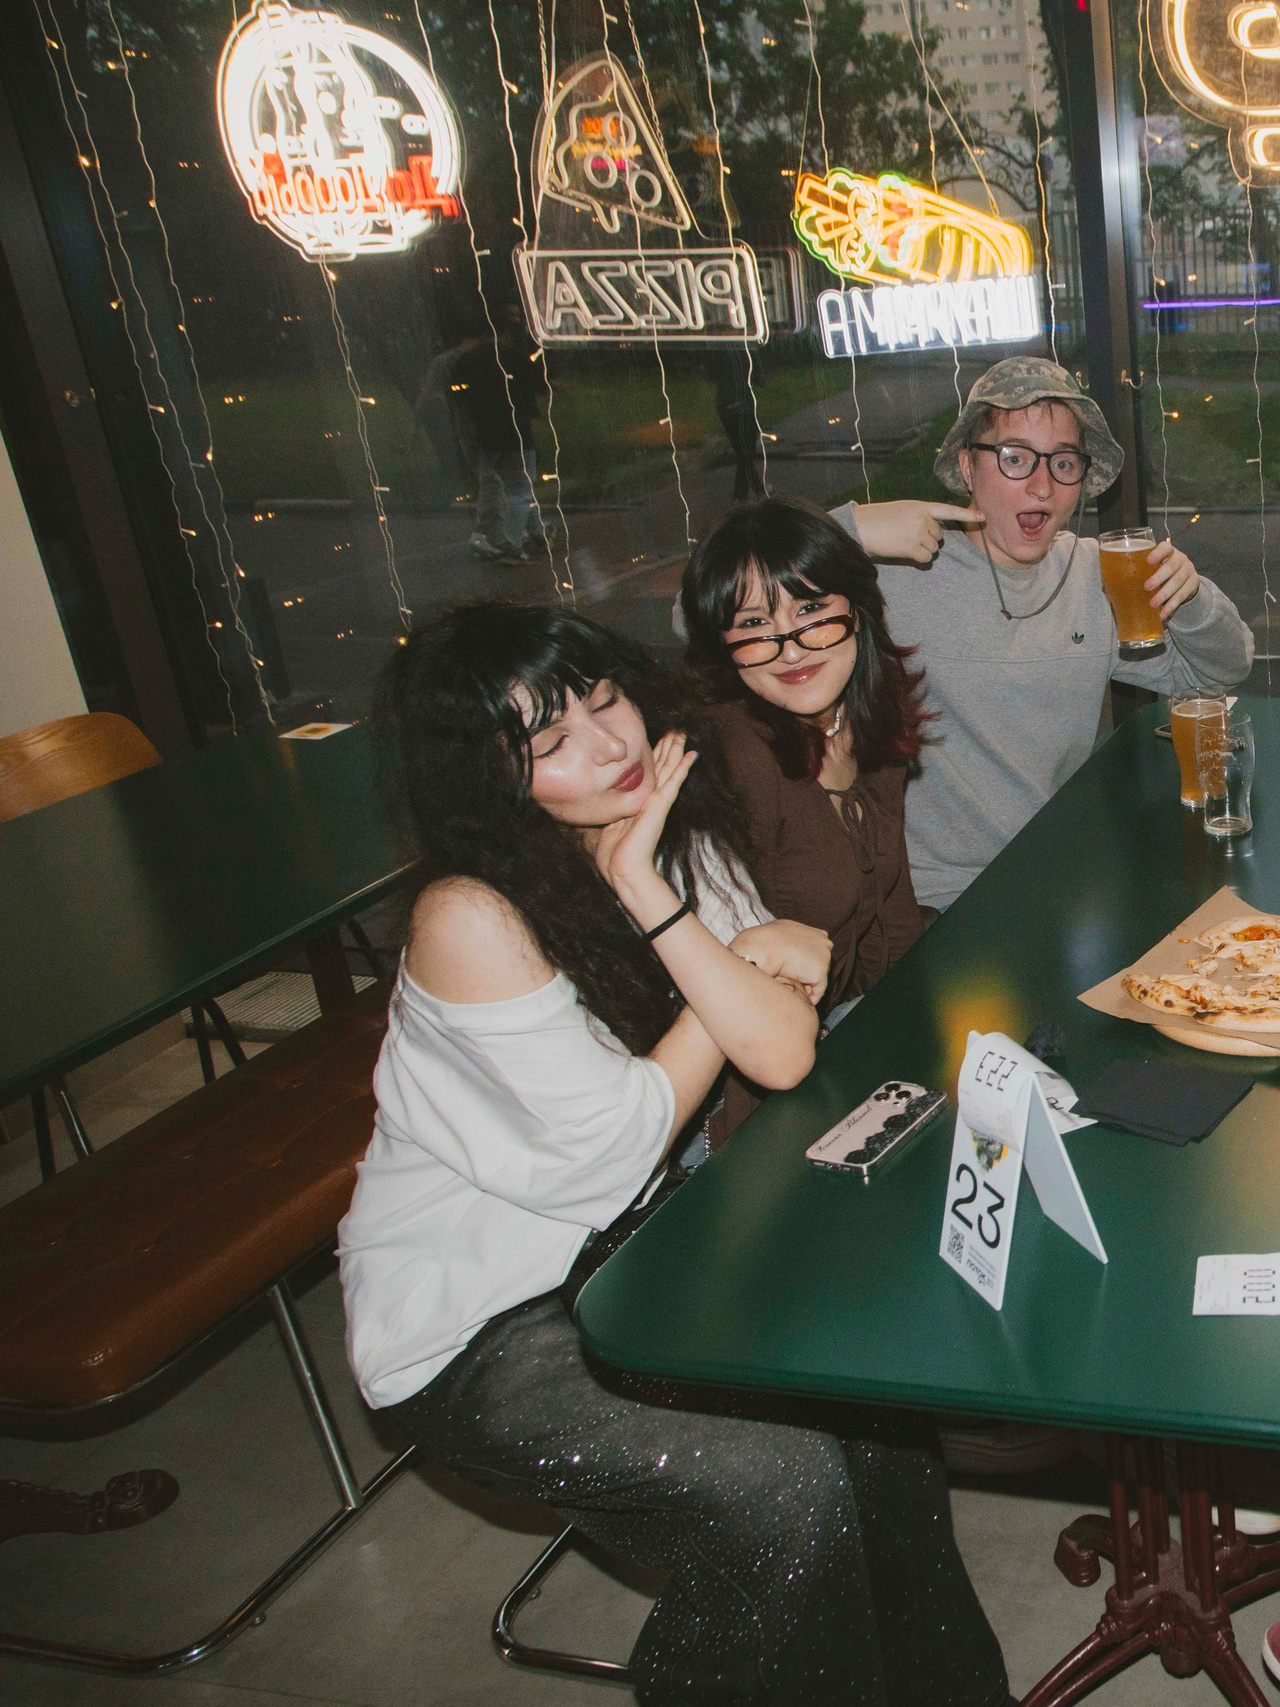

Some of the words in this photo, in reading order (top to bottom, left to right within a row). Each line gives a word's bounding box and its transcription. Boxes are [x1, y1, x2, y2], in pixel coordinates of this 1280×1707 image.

[838, 1105, 872, 1133] Blessed
[950, 1162, 1006, 1249] 23
[1242, 1267, 1276, 1303] 200
